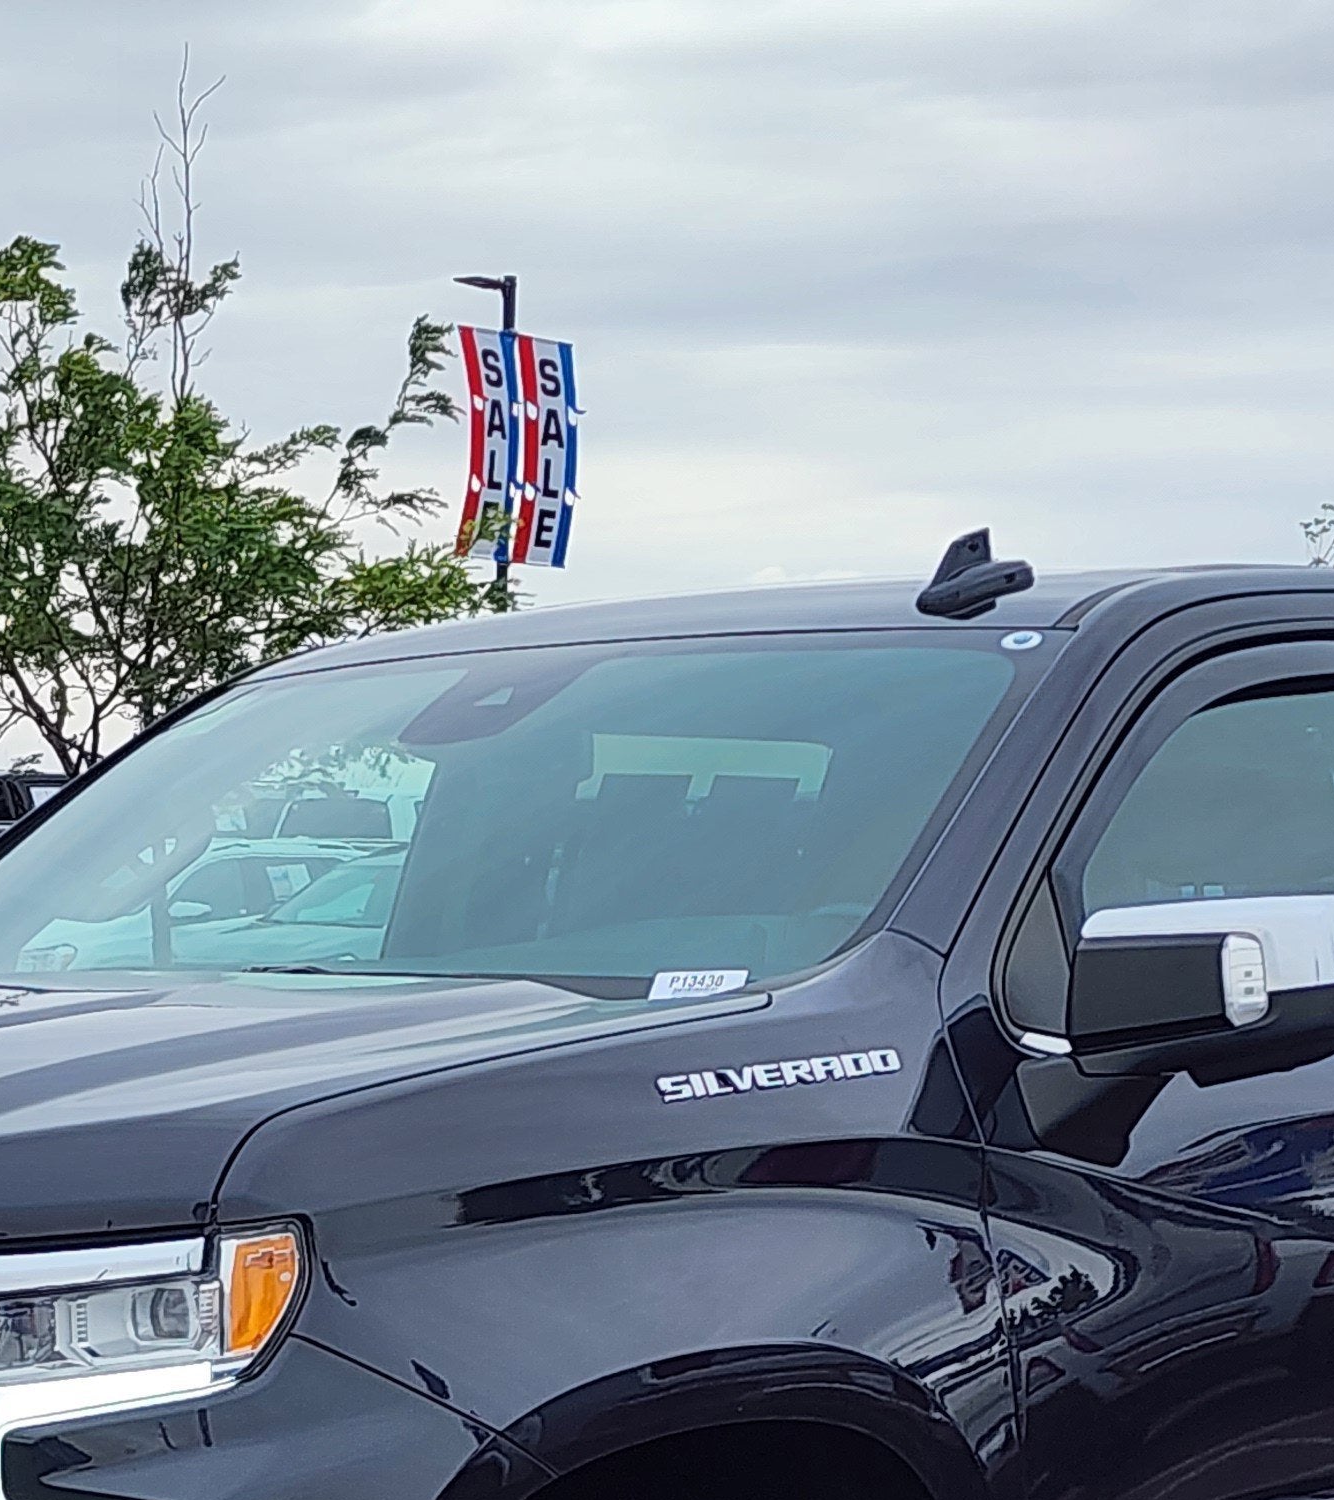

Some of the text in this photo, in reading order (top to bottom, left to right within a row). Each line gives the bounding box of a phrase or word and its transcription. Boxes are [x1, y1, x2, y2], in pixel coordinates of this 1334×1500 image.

[533, 358, 565, 549] SALE
[669, 974, 725, 988] P13430
[656, 1048, 902, 1102] SILVERADO
